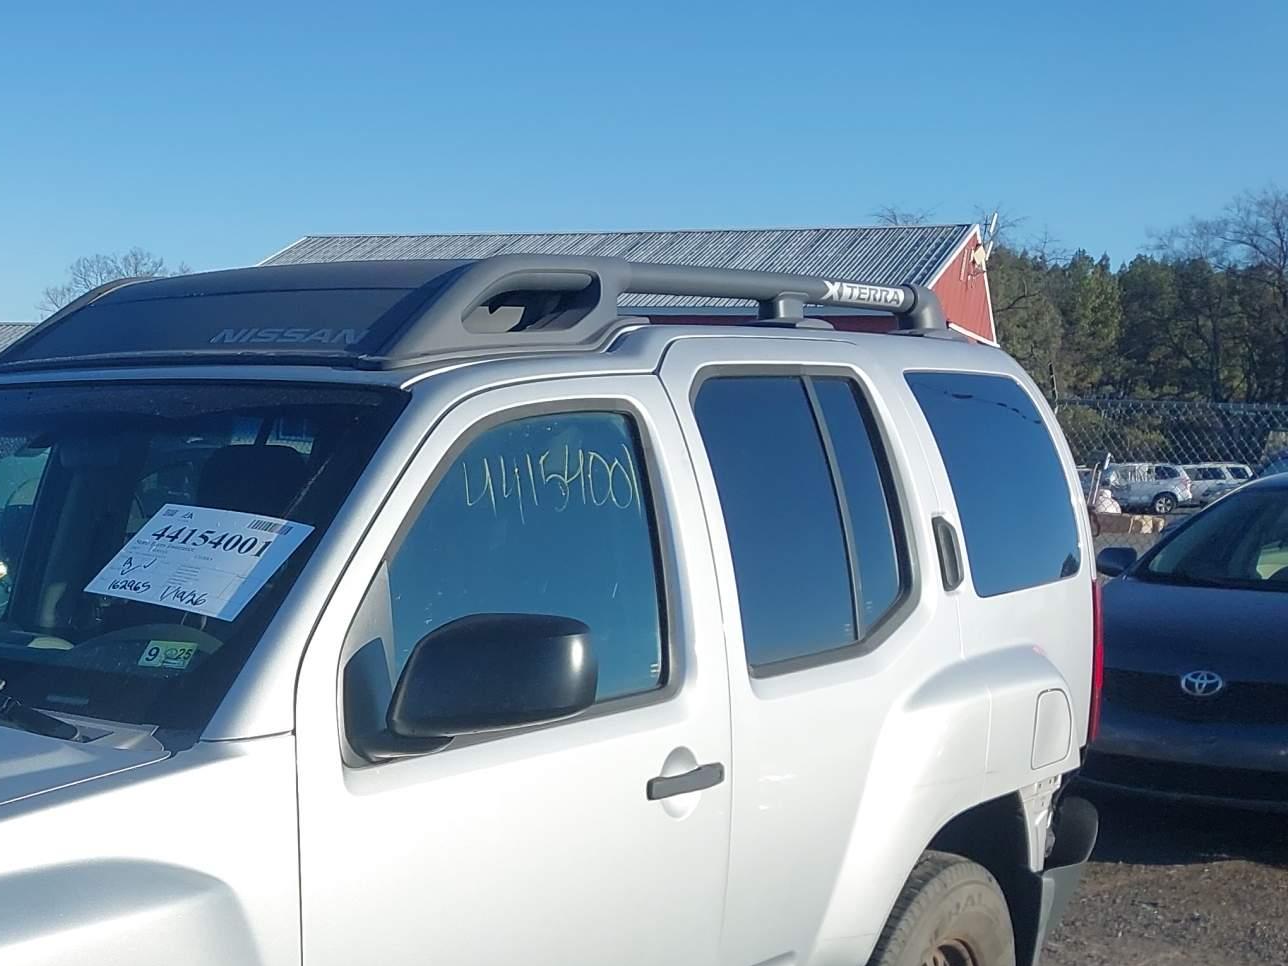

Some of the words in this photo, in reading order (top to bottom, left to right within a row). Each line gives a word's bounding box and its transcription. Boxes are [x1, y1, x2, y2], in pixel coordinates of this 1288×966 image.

[821, 280, 904, 307] XTERRA
[210, 328, 369, 344] NISSAN
[463, 443, 642, 525] 44154001
[152, 525, 273, 558] 44154001
[145, 646, 160, 661] 9
